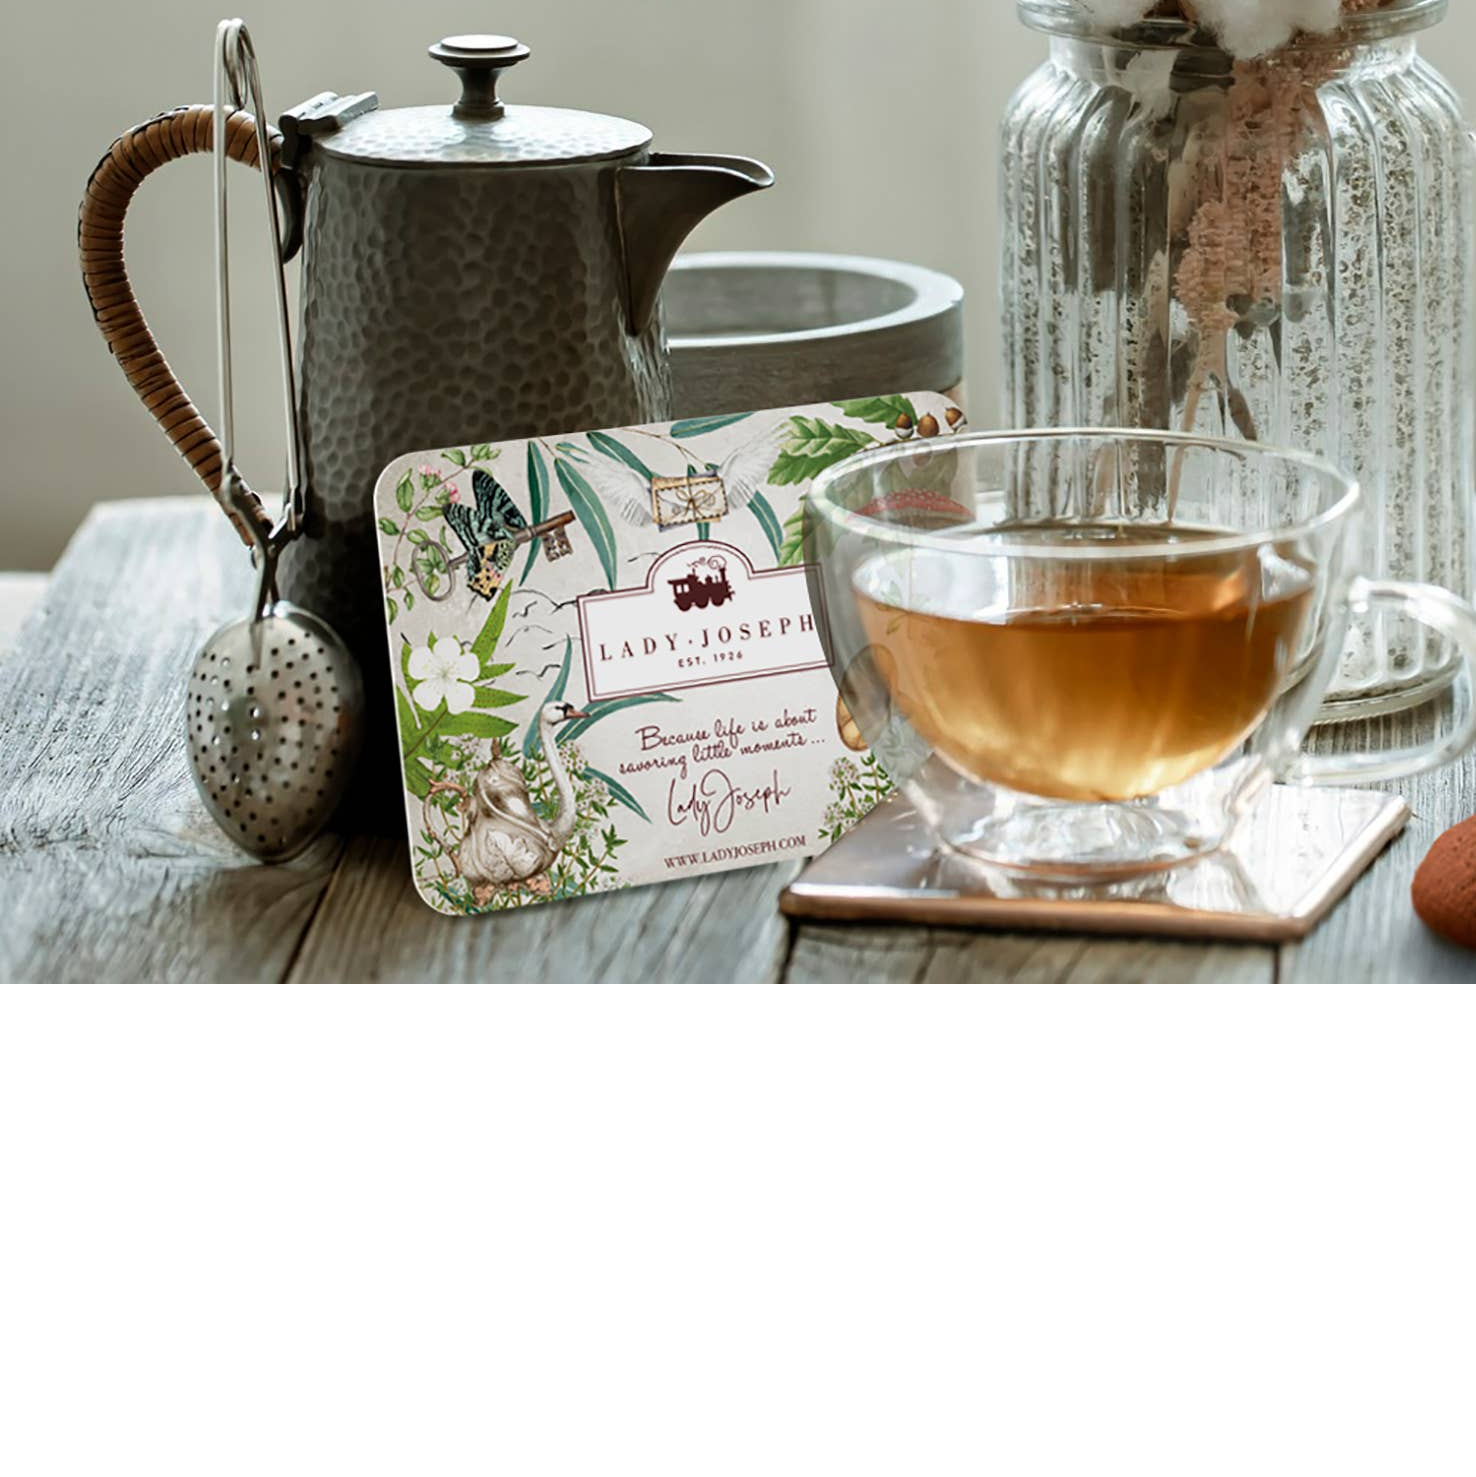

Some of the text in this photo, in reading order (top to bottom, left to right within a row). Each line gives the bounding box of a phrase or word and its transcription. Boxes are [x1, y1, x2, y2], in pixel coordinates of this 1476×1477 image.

[677, 651, 744, 668] EST. 1926
[635, 708, 818, 751] Because life is about
[619, 754, 689, 779] savoring
[691, 739, 733, 763] little
[740, 731, 808, 756] moments
[667, 768, 792, 837] Lady Joseph
[664, 835, 807, 869] WWW.LADYJOSEPH.COM
